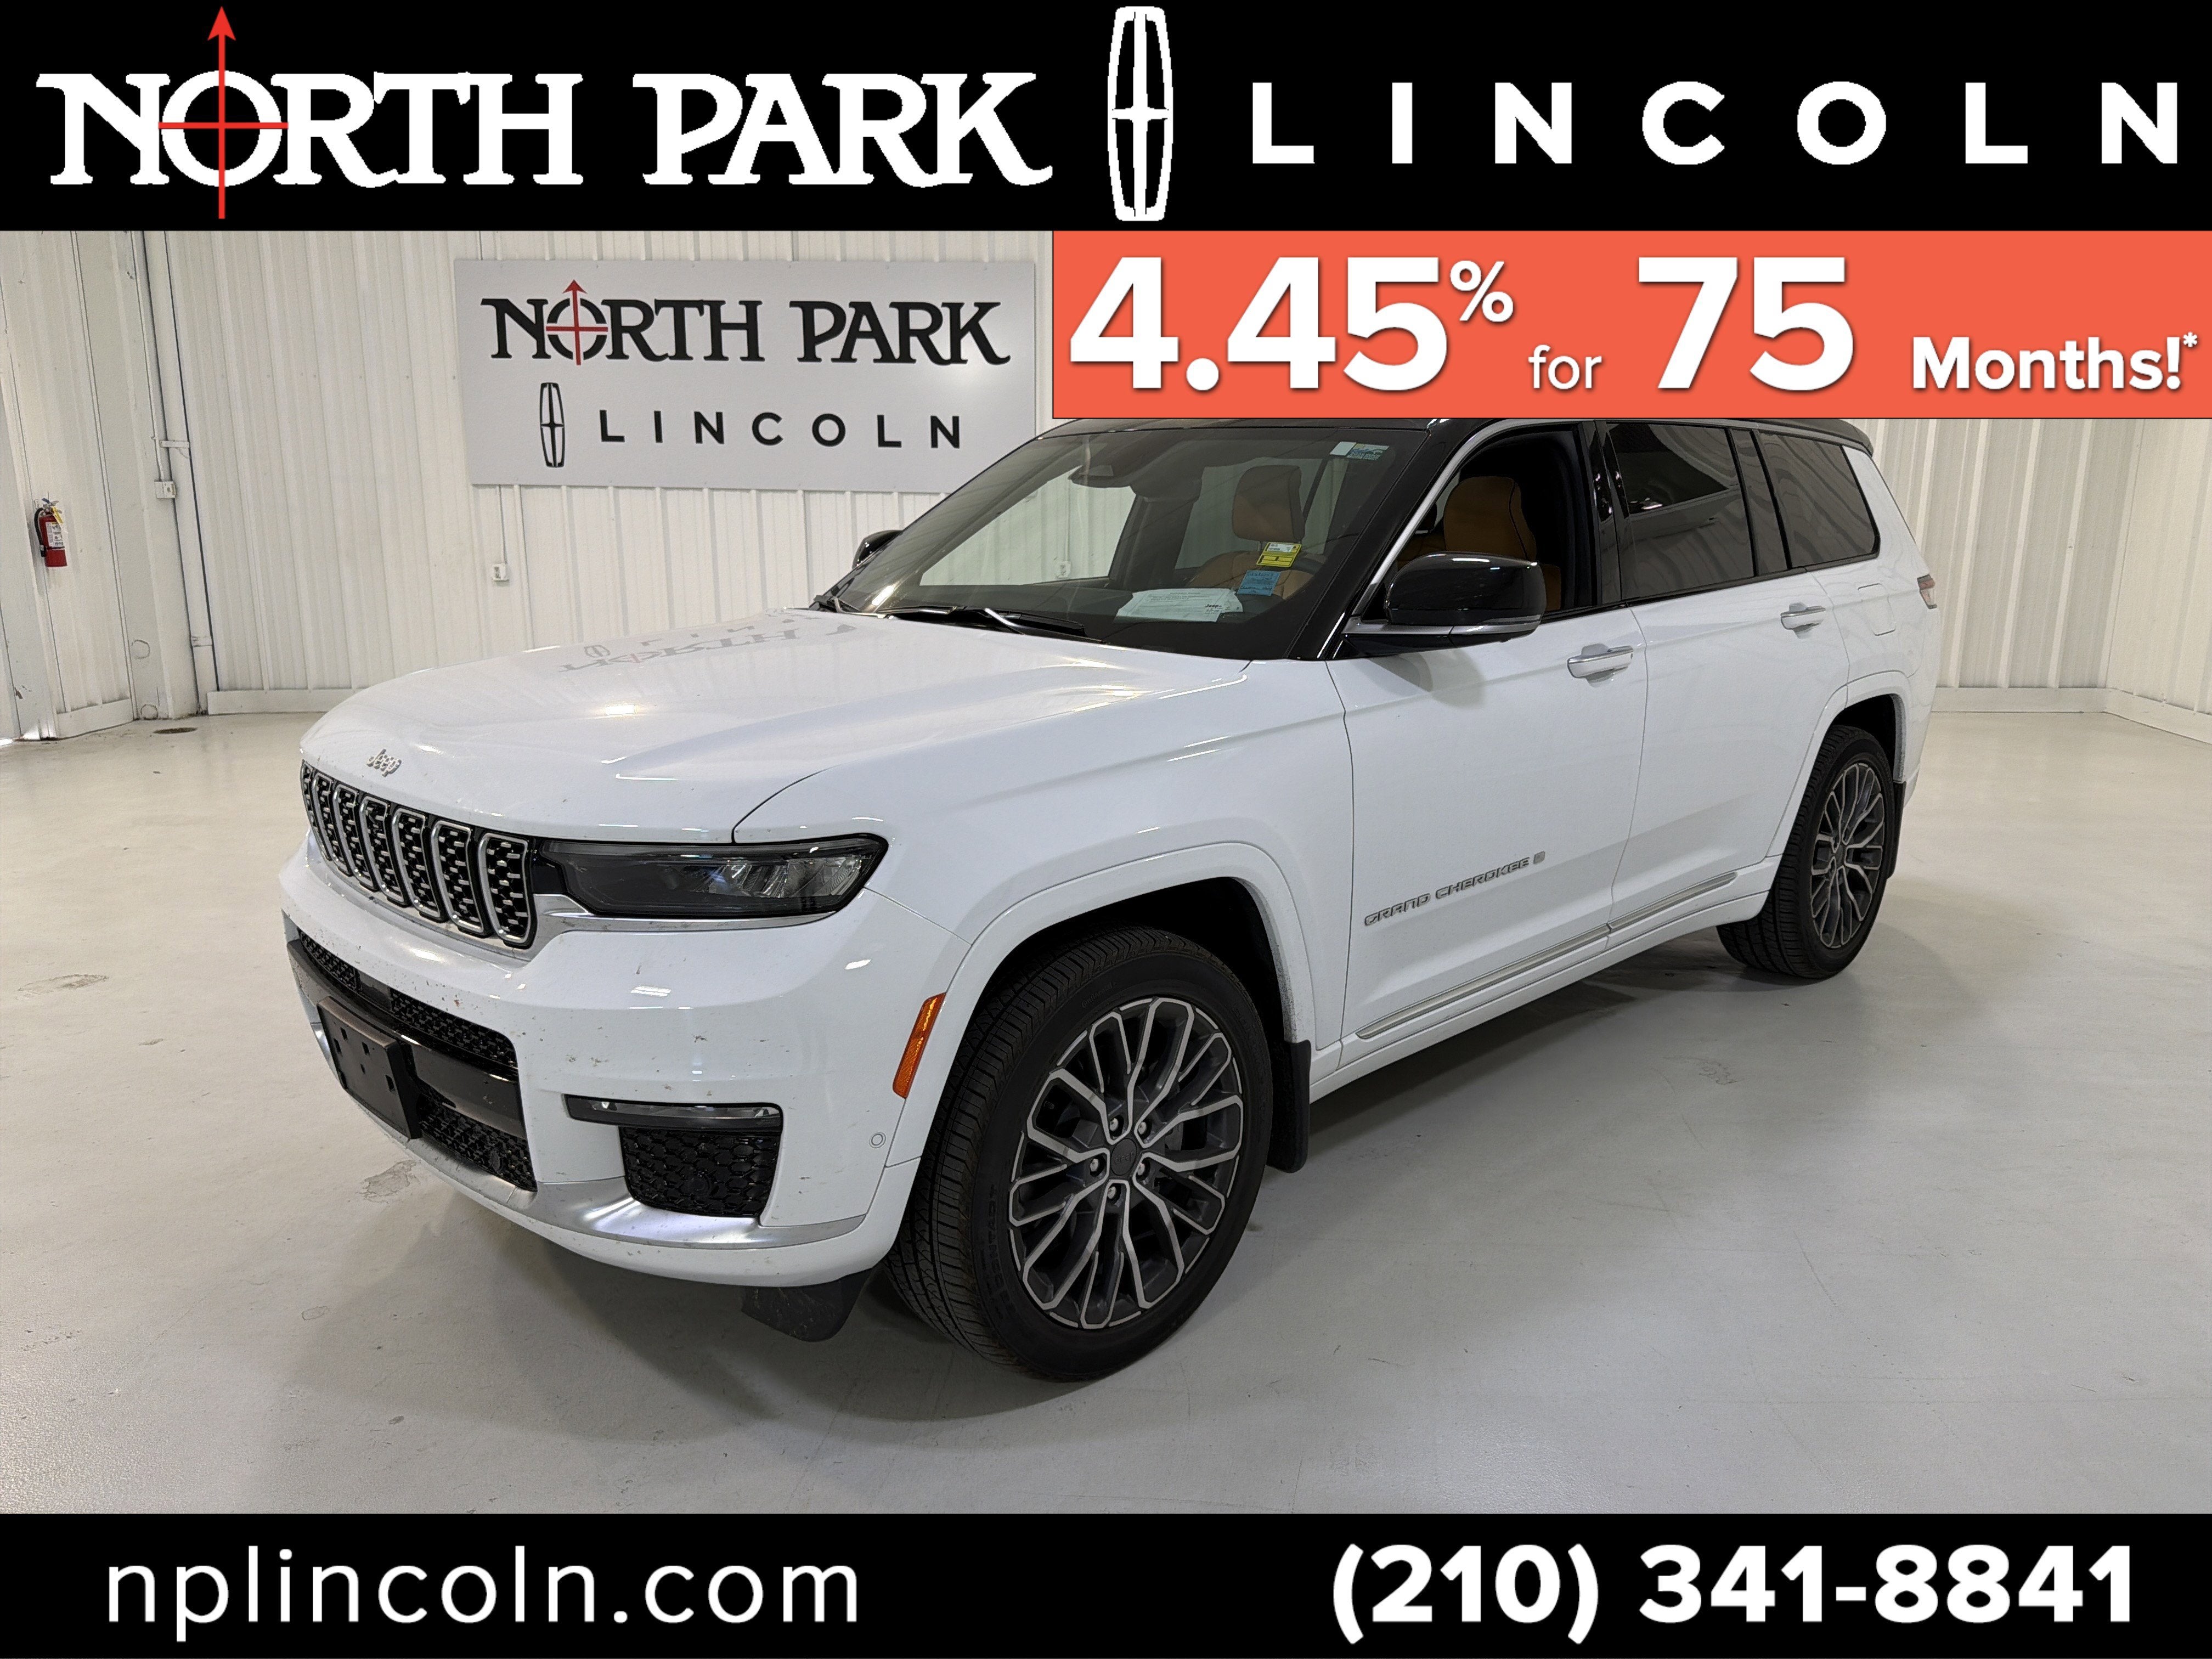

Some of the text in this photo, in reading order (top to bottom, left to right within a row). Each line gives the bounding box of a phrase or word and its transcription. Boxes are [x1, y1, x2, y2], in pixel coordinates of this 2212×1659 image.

[481, 297, 1011, 366] NORTH PARK
[599, 410, 960, 449] LINCOLN
[366, 749, 402, 777] Jeep
[1364, 856, 1530, 927] GRAND CHEROKEE
